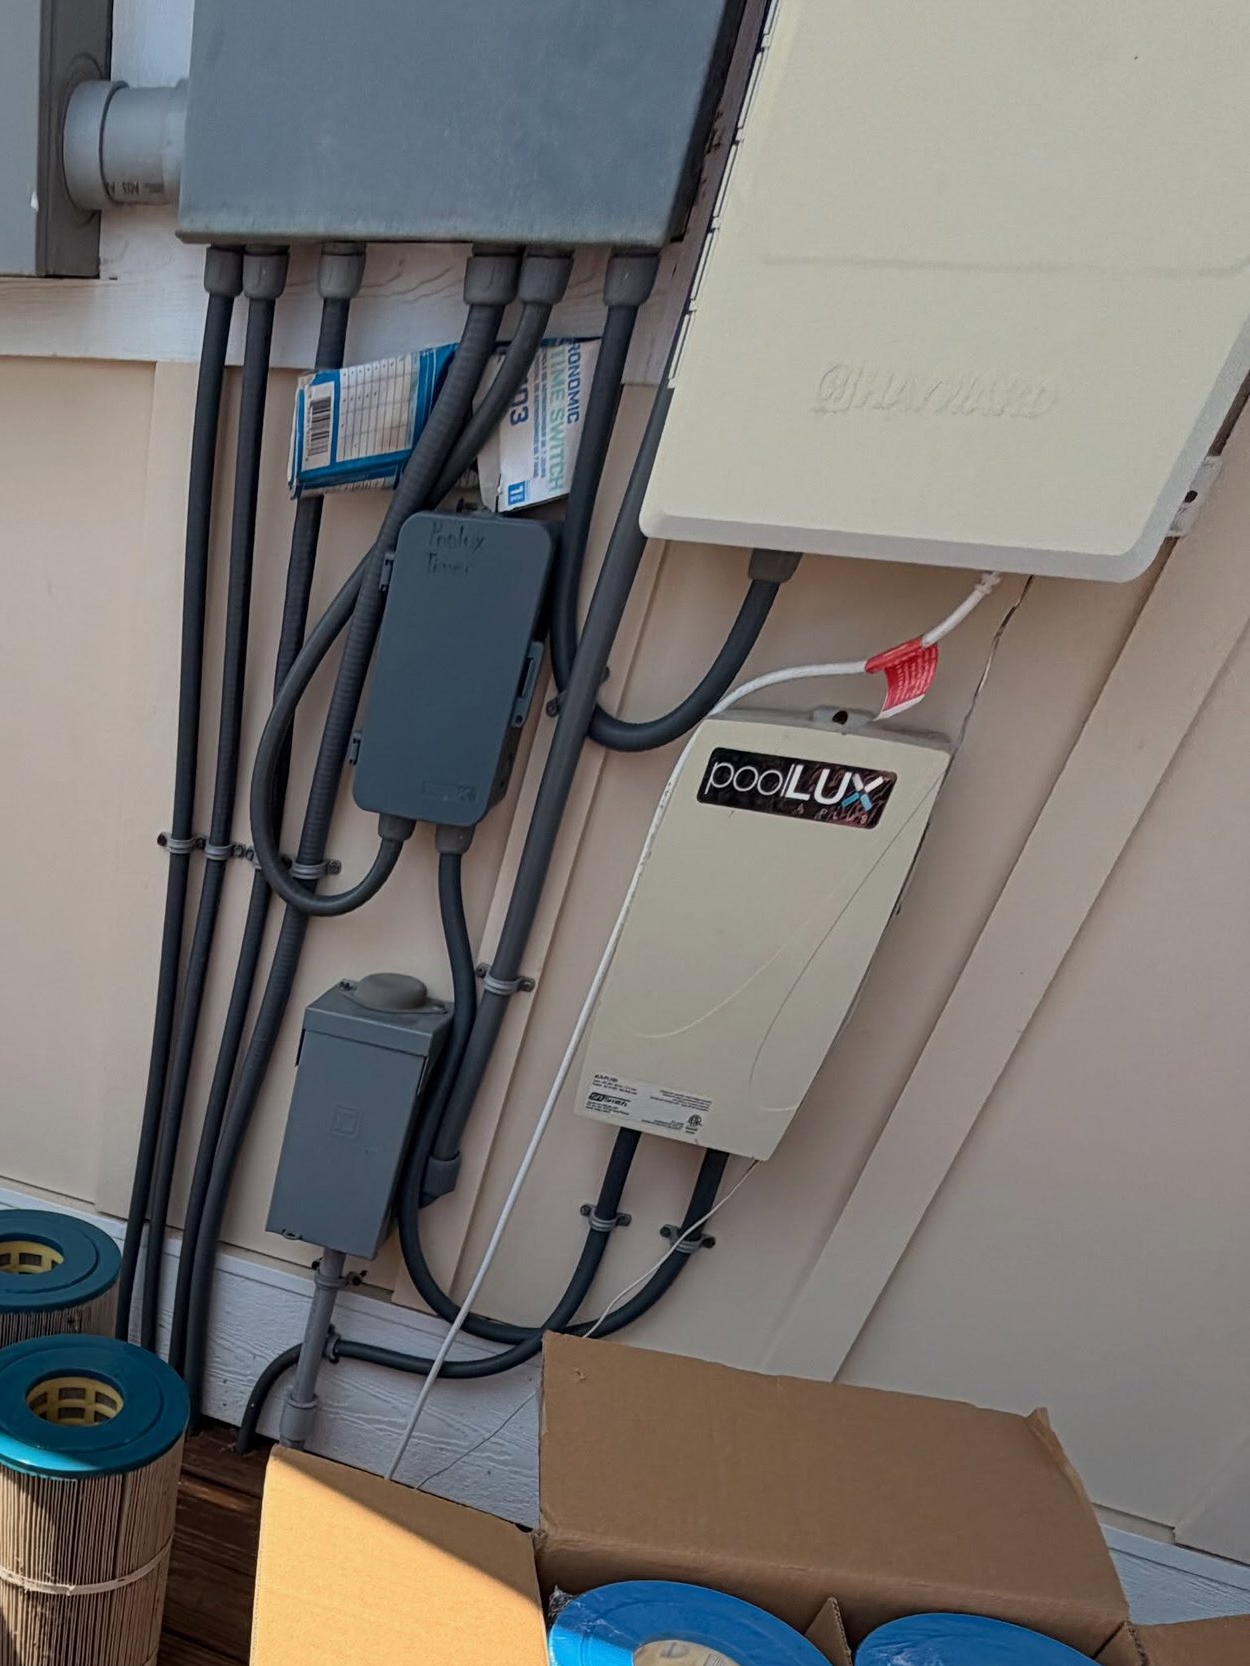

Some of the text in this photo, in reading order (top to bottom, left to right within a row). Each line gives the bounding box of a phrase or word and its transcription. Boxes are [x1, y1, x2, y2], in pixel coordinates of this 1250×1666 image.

[548, 346, 565, 493] TIME SWITCH
[567, 343, 581, 425] RONOMIC
[705, 761, 885, 812] poolLUX
